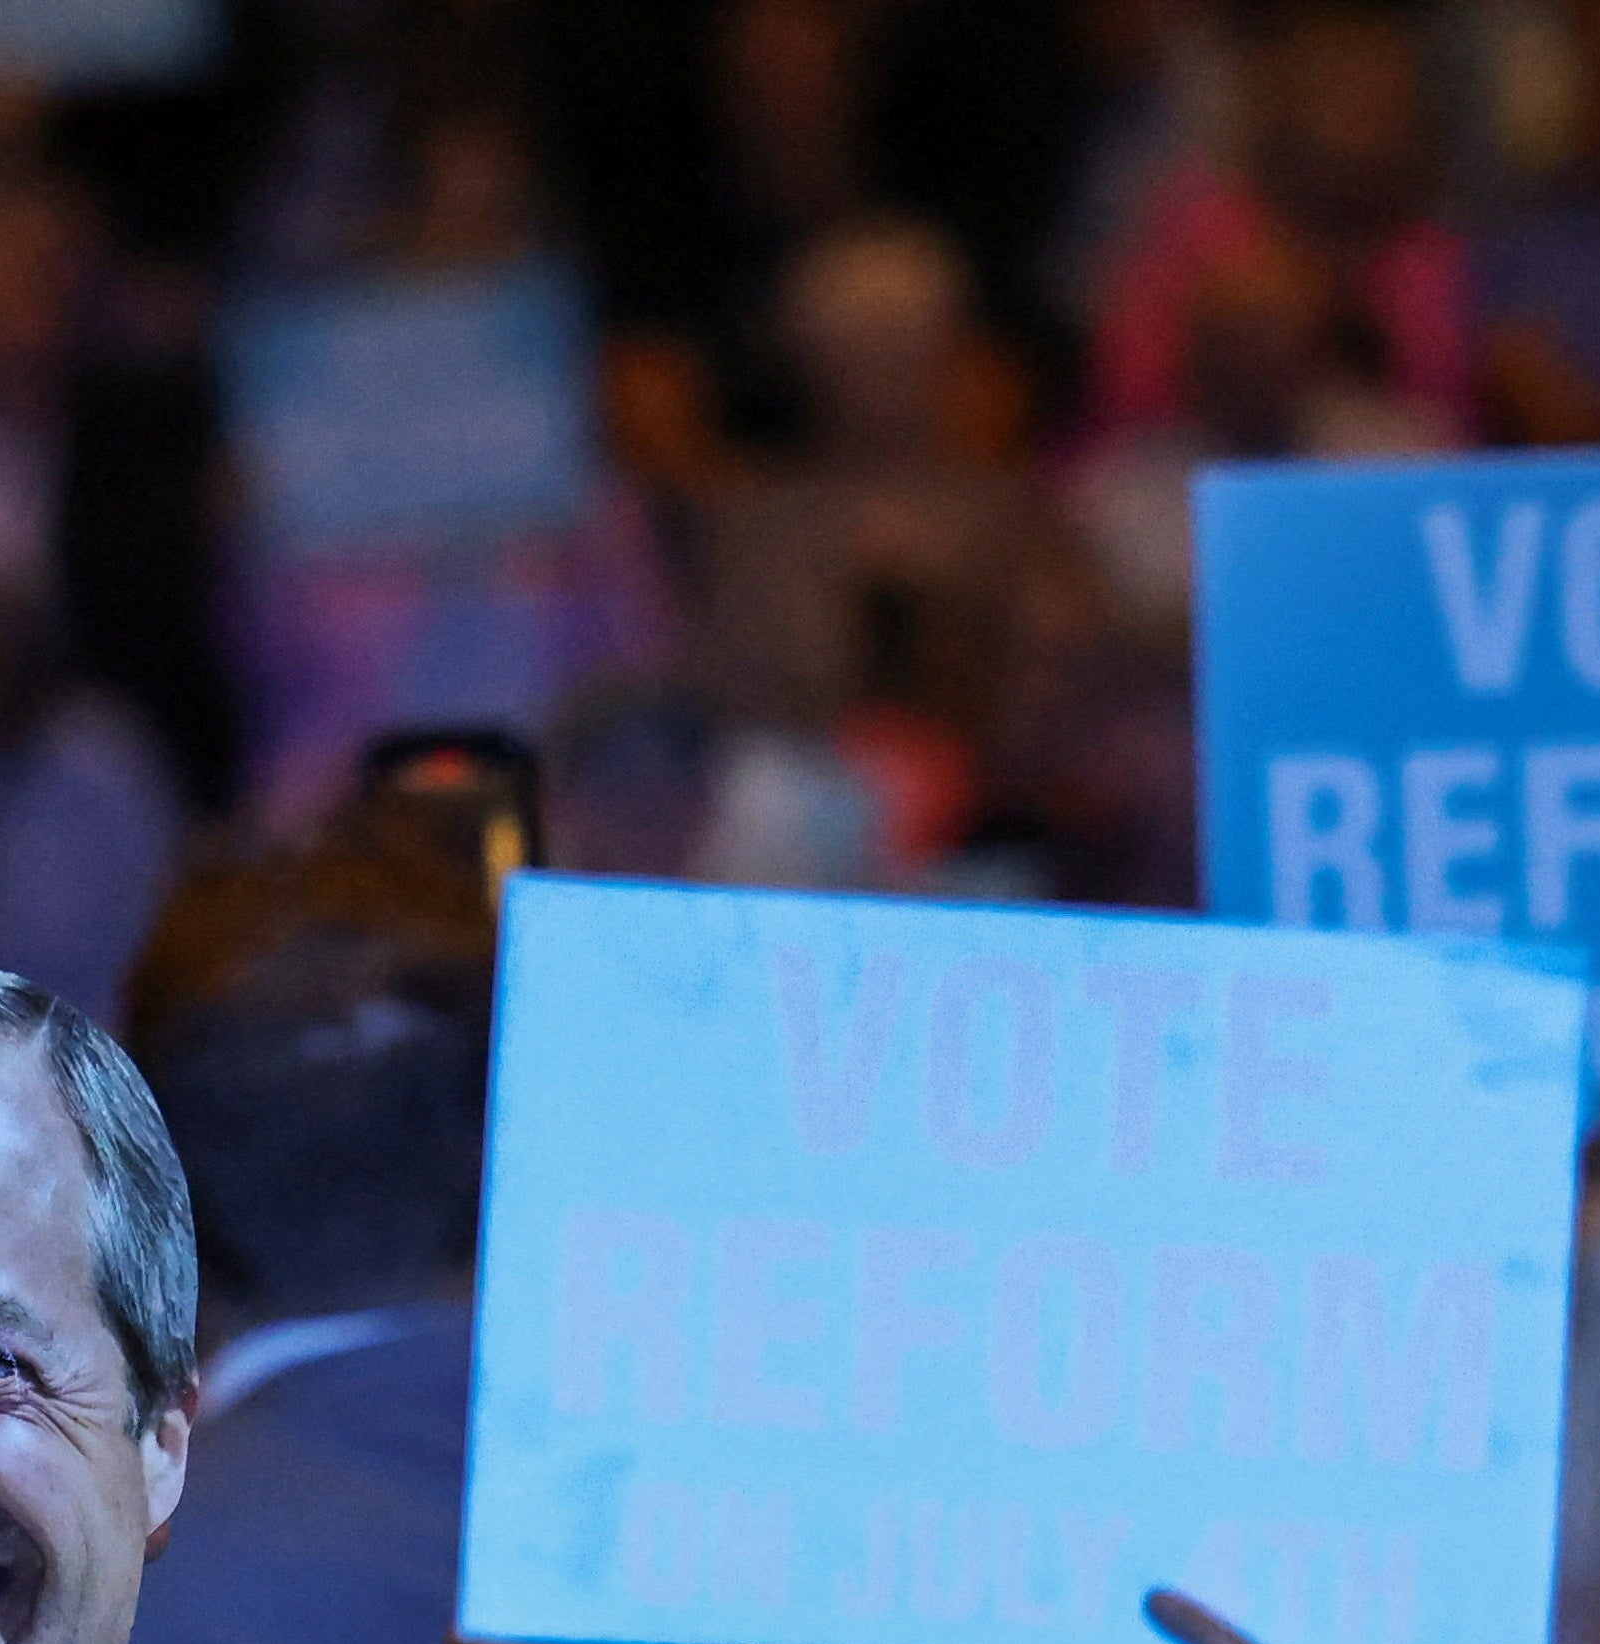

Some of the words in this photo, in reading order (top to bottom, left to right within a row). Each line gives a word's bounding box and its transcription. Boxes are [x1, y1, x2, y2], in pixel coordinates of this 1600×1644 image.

[766, 942, 1339, 1185] VOTE
[552, 1206, 1501, 1473] REFORM
[621, 1479, 793, 1609] ON
[835, 1494, 1135, 1631] JULY
